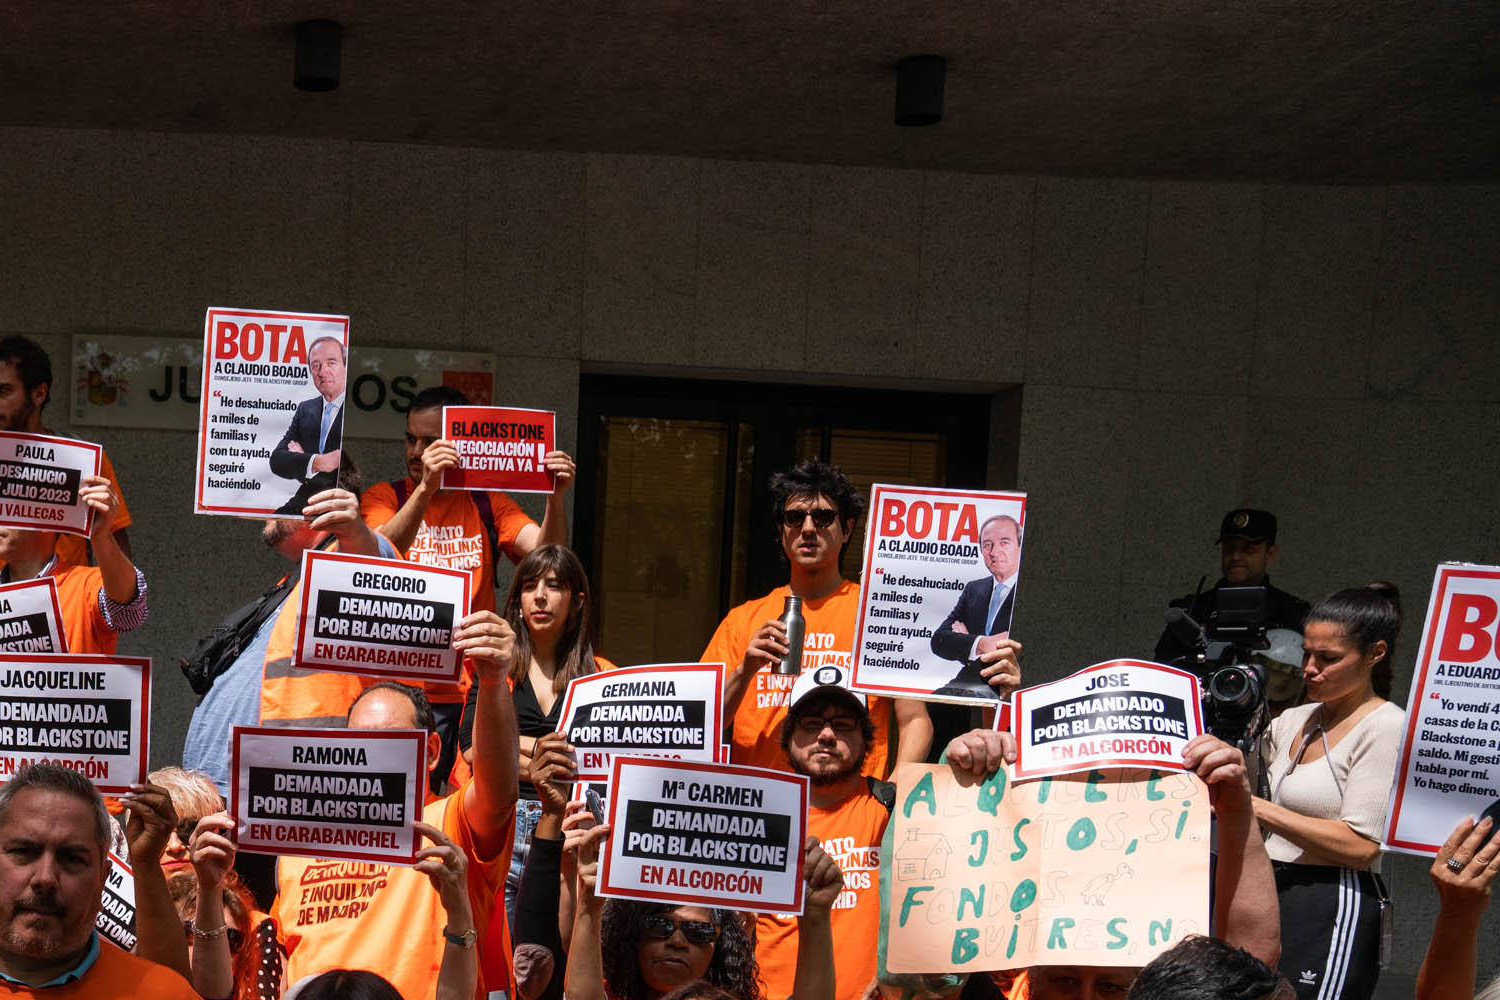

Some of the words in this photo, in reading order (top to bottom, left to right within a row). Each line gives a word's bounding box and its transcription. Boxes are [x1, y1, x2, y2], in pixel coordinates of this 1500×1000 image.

[215, 321, 308, 364] BOTA
[452, 422, 544, 440] BLACKSTONE
[16, 444, 55, 461] PAULA
[0, 464, 67, 485] DESAHUCIO
[209, 462, 244, 475] seguiré
[2, 484, 37, 499] JULIO
[40, 488, 71, 502] 2023
[208, 477, 261, 490] haciéndolo
[4, 504, 65, 521] VALLECAS
[880, 499, 979, 543] BOTA
[879, 539, 886, 551] A
[888, 539, 938, 555] CLAUDIO
[940, 544, 978, 558] BOADA
[353, 572, 426, 594] GREGORIO
[339, 597, 434, 622] DEMANDADO
[319, 617, 349, 635] POR
[351, 621, 450, 645] BLACKSTONE
[314, 643, 333, 659] EN
[336, 645, 444, 669] CARABANCHEL
[866, 640, 904, 654] seguiré
[863, 655, 920, 670] haciéndolo
[0, 670, 106, 690] JACQUELINE
[602, 681, 676, 698] GERMANIA
[0, 702, 108, 724] DEMANDADA
[590, 705, 685, 722] DEMANDADA
[1054, 696, 1164, 720] DEMANDADO
[16, 729, 129, 749] BLACKSTONE
[1034, 722, 1069, 742] POR
[1072, 715, 1186, 737] BLACKSTONE
[292, 746, 367, 766] RAMONA
[1415, 761, 1448, 775] habla
[1450, 767, 1469, 780] por
[1471, 767, 1489, 780] mí.
[274, 773, 384, 797] DEMANDADA
[662, 780, 684, 799] Mª
[688, 782, 763, 807] CARMEN
[253, 796, 287, 815] POR
[290, 798, 403, 822] BLACKSTONE
[652, 809, 766, 838] DEMANDADA
[251, 824, 272, 840] EN
[275, 825, 399, 849] CARABANCHEL
[628, 832, 667, 853] POR
[668, 836, 786, 866] BLACKSTONE
[640, 865, 663, 884] EN
[666, 867, 763, 894] ALCORCÓN
